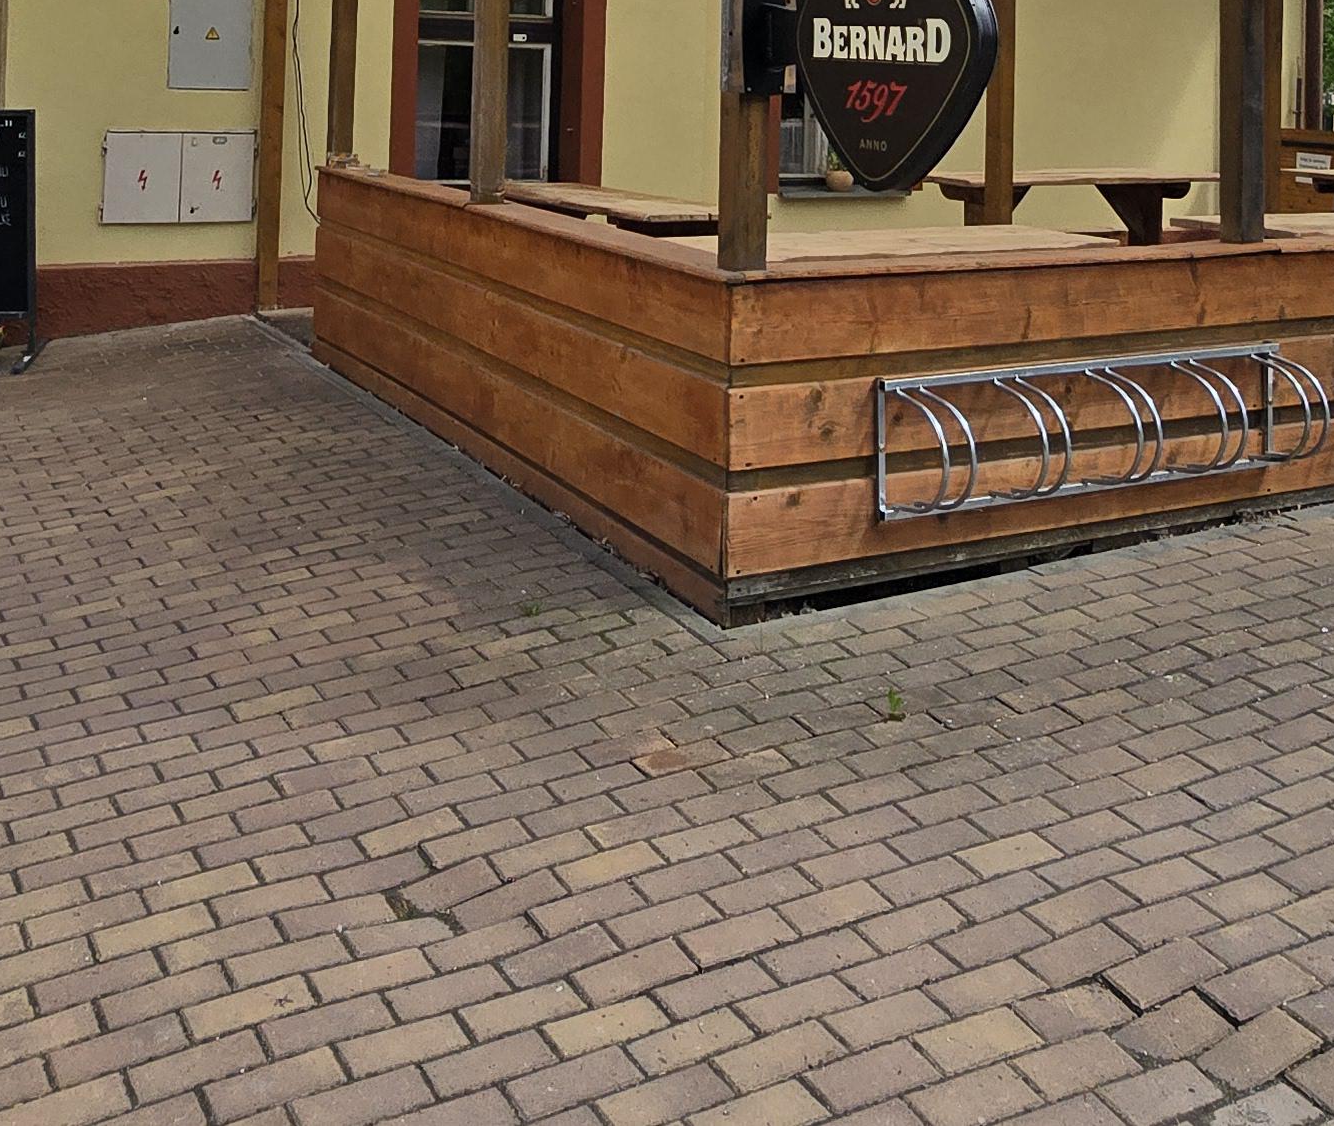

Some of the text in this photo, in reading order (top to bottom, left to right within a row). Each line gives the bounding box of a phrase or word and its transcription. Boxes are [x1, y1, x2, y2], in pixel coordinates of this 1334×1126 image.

[812, 17, 951, 63] BERNARD
[845, 80, 907, 123] 1597
[859, 138, 887, 151] ANNO
